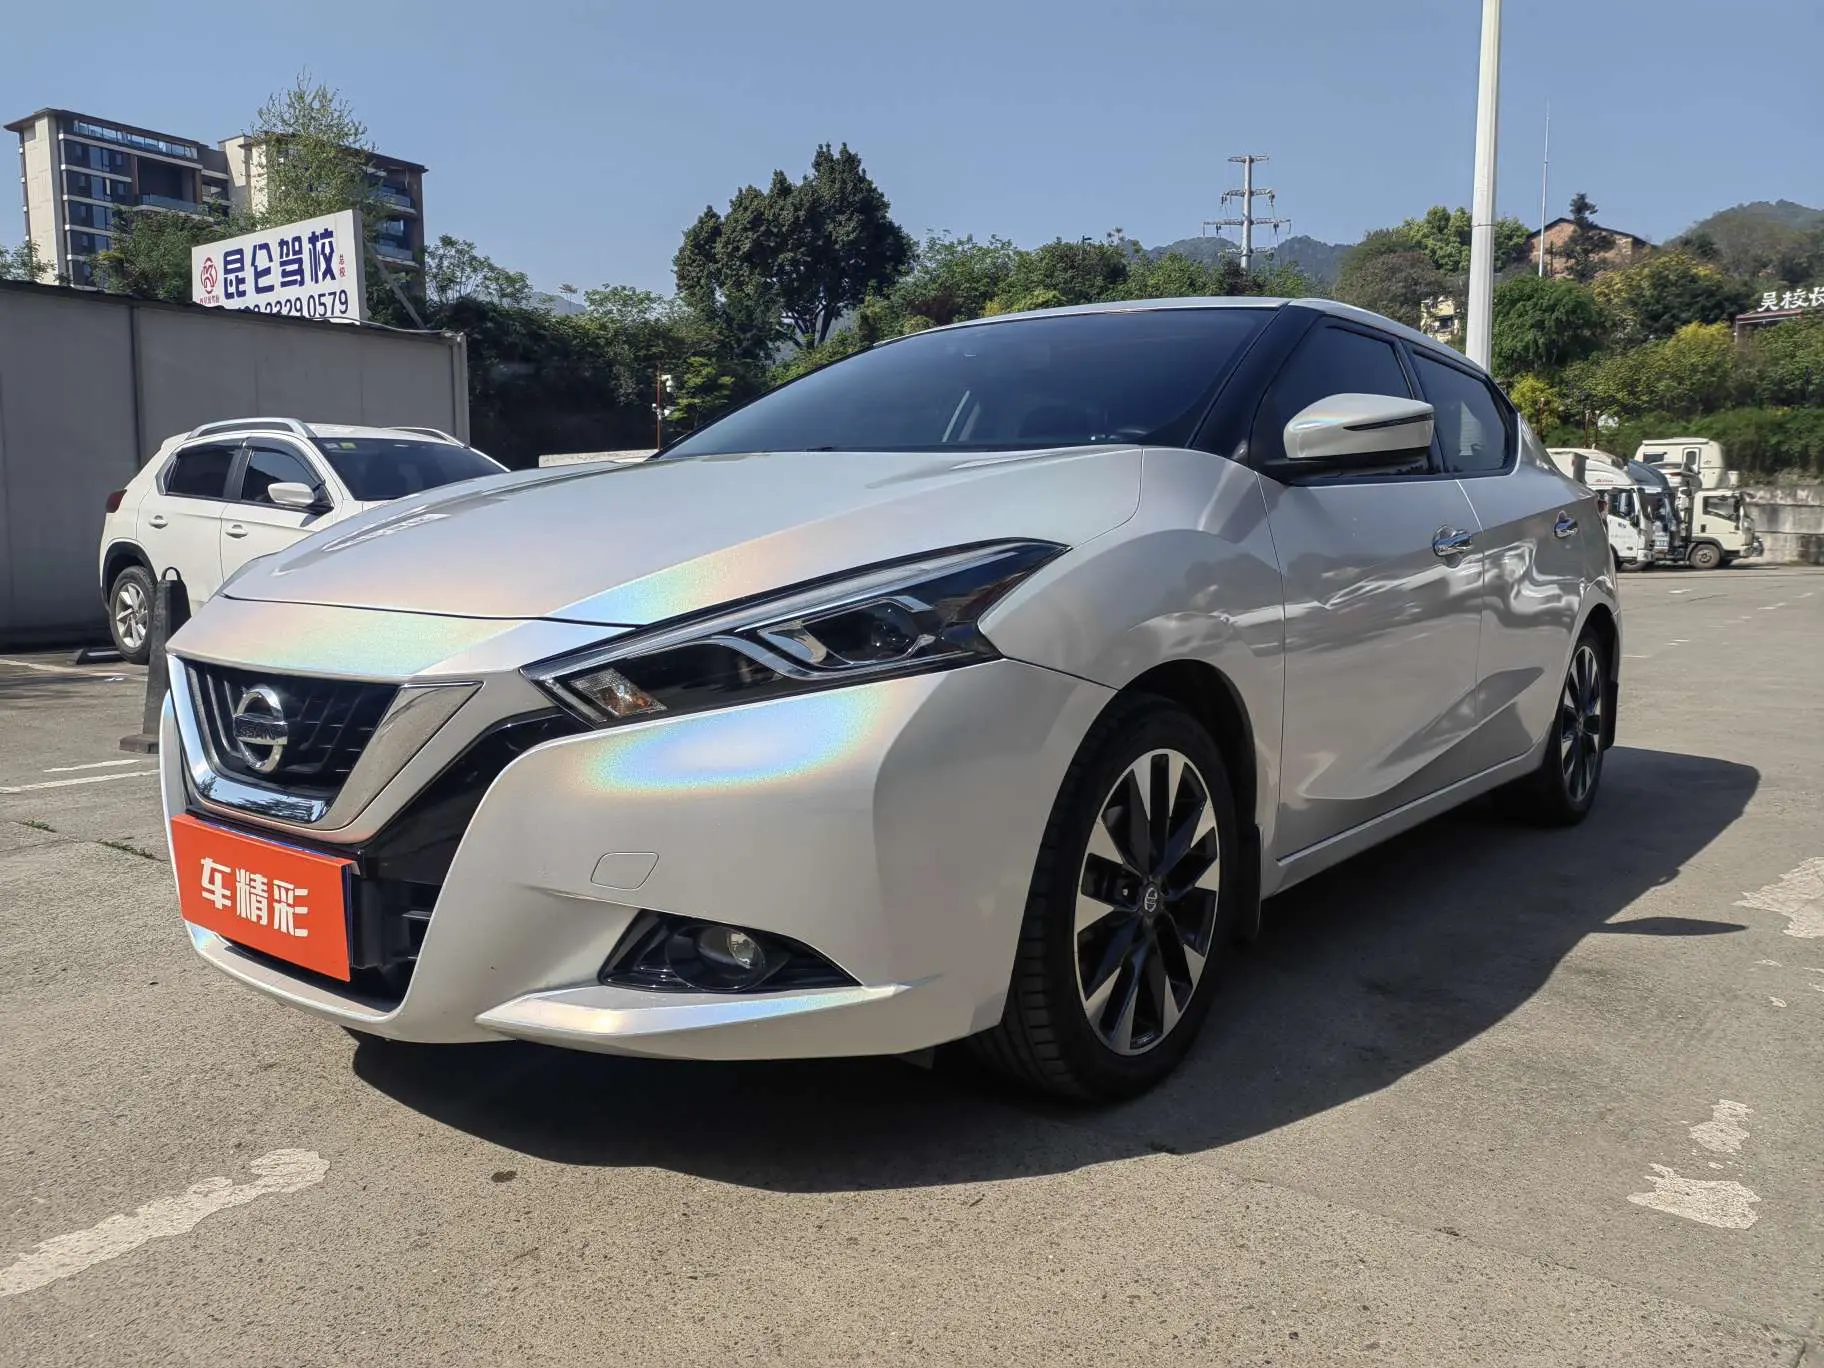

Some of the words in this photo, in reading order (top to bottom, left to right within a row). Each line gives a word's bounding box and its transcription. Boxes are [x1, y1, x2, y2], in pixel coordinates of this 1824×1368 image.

[223, 228, 336, 300] 昆仑驾校
[307, 289, 349, 318] 0579
[200, 857, 308, 937] 车精彩
